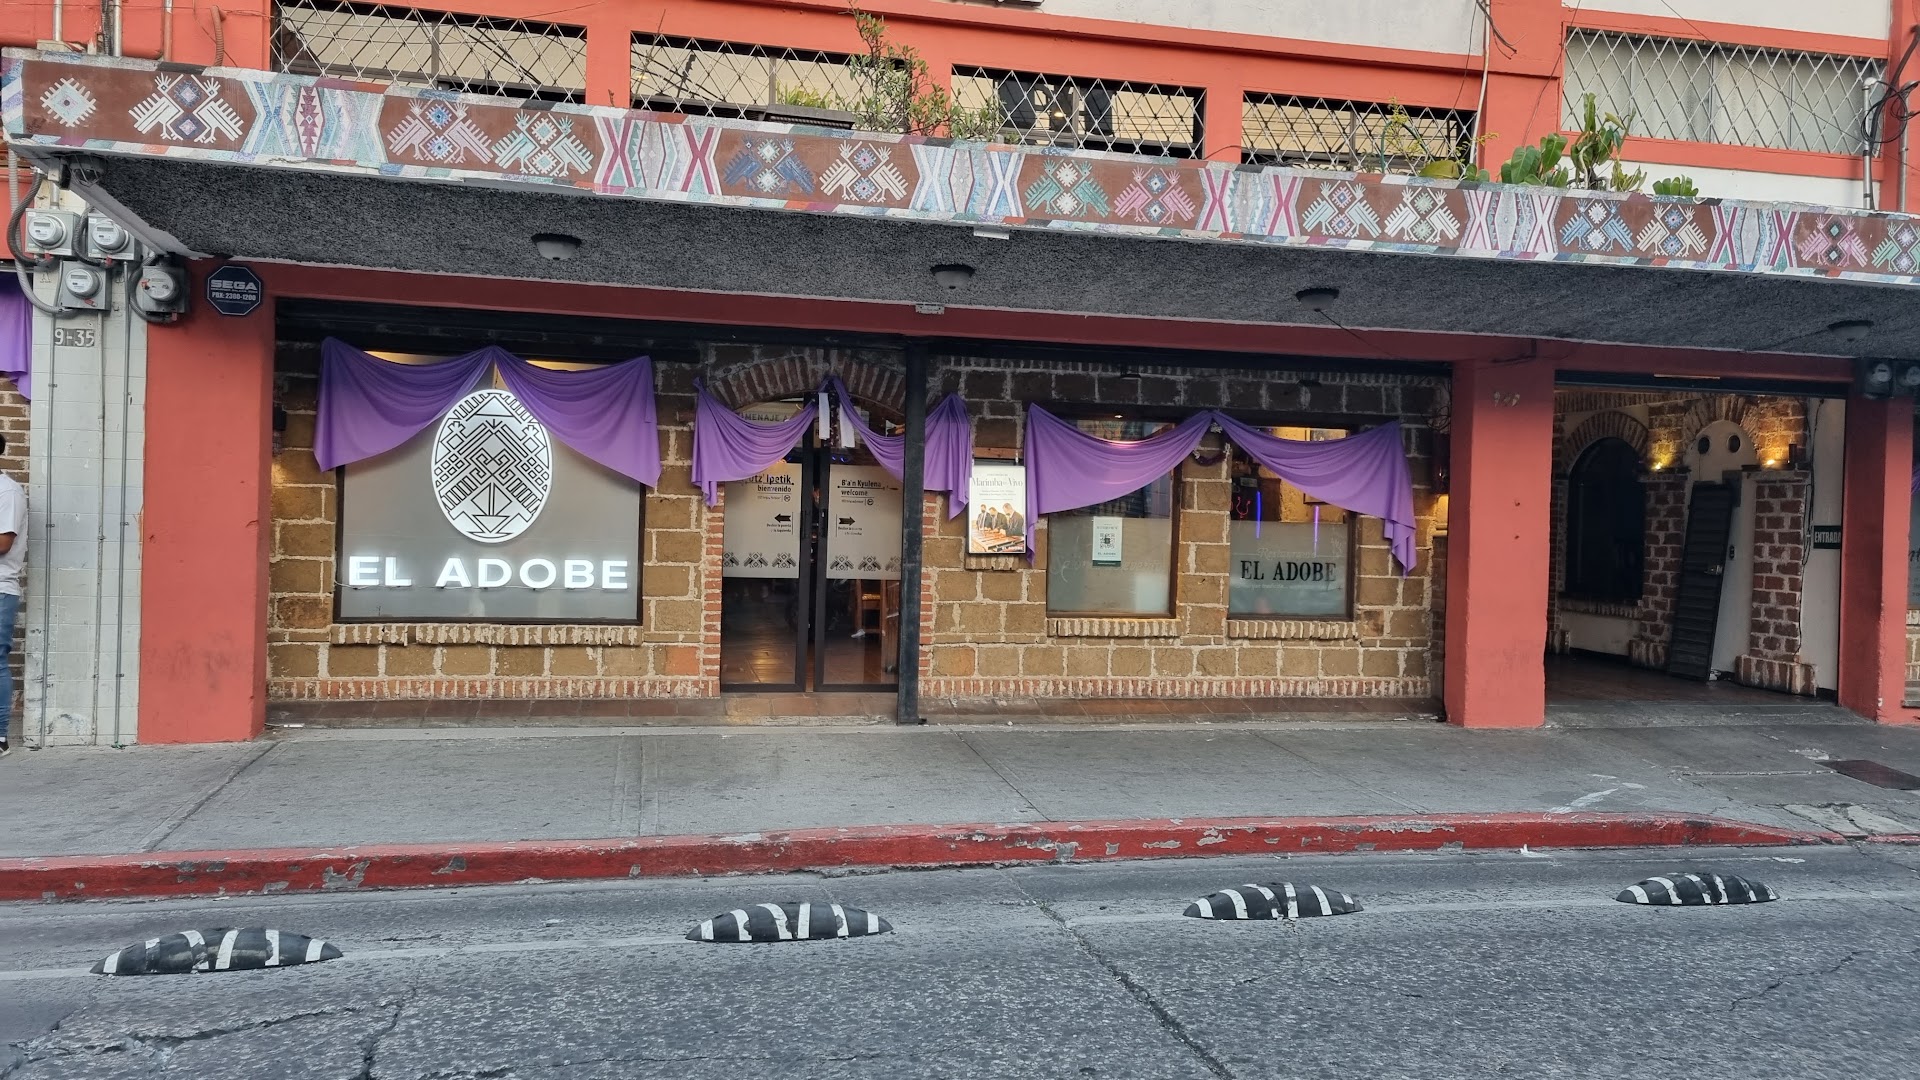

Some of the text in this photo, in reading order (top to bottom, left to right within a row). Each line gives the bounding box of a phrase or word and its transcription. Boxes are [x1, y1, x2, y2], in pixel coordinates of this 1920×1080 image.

[211, 279, 258, 291] SEGA
[54, 328, 95, 347] 9-35
[741, 412, 779, 422] MENAJE
[757, 485, 792, 493] bienvenido
[1814, 531, 1841, 543] ENTRADA
[349, 556, 628, 589] EL ADOBE
[1240, 560, 1337, 582] EL ADOBE
